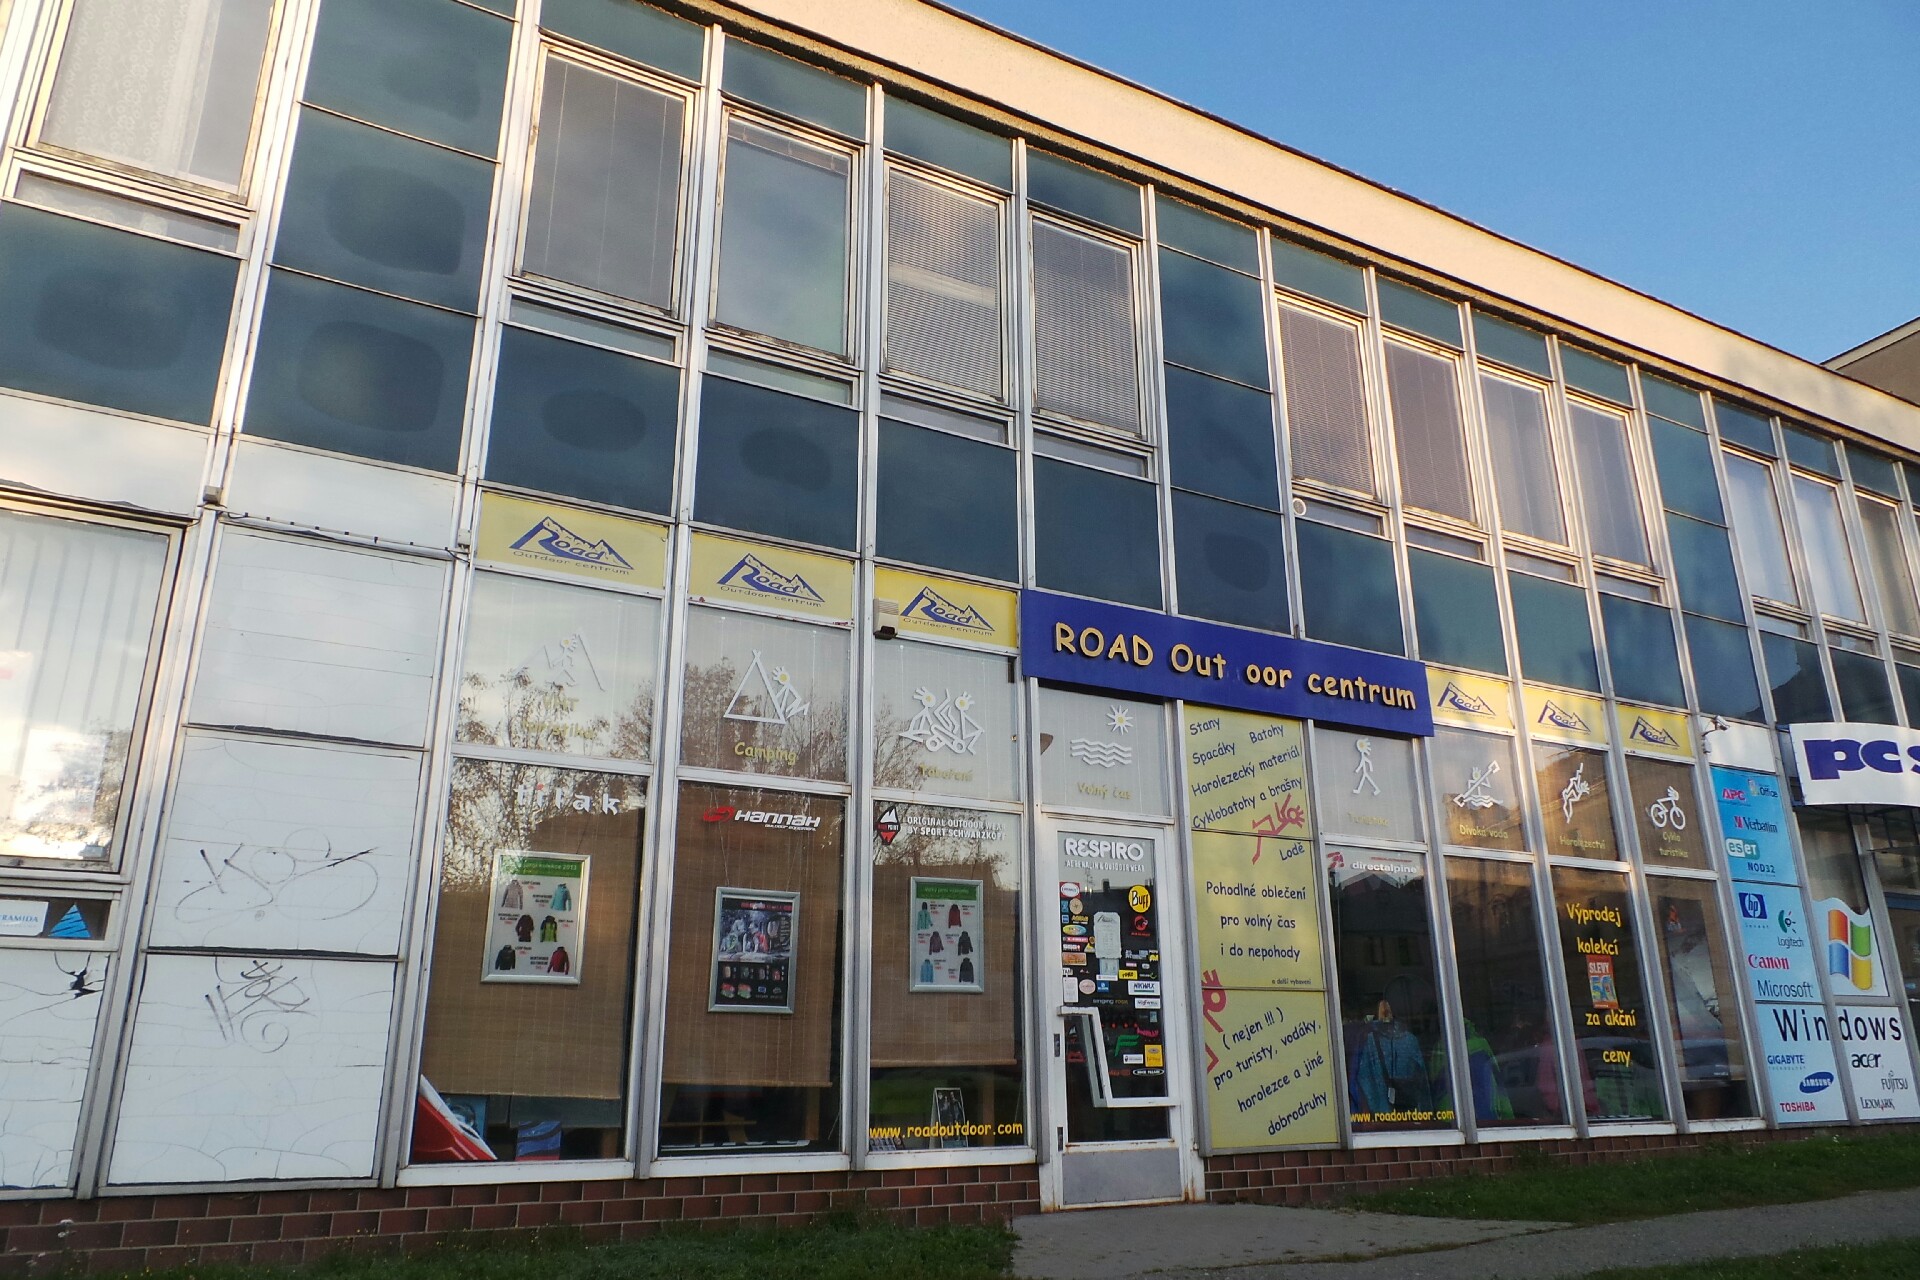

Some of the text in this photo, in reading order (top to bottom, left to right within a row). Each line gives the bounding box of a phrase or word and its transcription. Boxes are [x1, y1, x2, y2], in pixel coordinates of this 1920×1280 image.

[513, 550, 630, 575] Outdoor centrum
[720, 586, 821, 608] Outdoor centrum
[1054, 622, 1154, 667] ROAD
[1307, 671, 1417, 710] centrum
[1189, 718, 1220, 735] Stany
[1249, 725, 1284, 744] Batohy
[735, 741, 797, 766] Camping
[1192, 742, 1235, 765] Spacáky
[1191, 745, 1300, 796] Horolezecký materiál
[1192, 777, 1302, 829] Cyklobatohy a brašny
[1723, 788, 1746, 801] APC
[907, 816, 945, 828] ORIGINAL
[947, 819, 984, 830] OUTDOOR
[907, 826, 919, 835] BY
[920, 826, 947, 836] SPORT
[1743, 817, 1778, 833] Verbatim
[1065, 838, 1145, 861] RESPIRO
[1279, 842, 1305, 861] Lodě
[1352, 861, 1417, 874] directalpine
[1747, 862, 1776, 874] NOD32
[1131, 890, 1149, 909] Buff
[1206, 881, 1306, 900] Pohodlné oblečení
[0, 914, 38, 922] RAMIDA
[1220, 913, 1296, 931] pro volný čas
[1566, 902, 1621, 927] Výprodej
[1577, 936, 1618, 955] kolekcí
[1777, 936, 1805, 949] Logitech
[1229, 943, 1244, 957] do
[1248, 945, 1301, 962] nepohody
[1589, 962, 1610, 974] SLEVY
[1748, 954, 1790, 970] Canon
[1757, 980, 1813, 998] Microsoft
[1585, 1009, 1636, 1027] za akční
[1232, 1020, 1263, 1045] nejen
[1213, 1069, 1233, 1091] pro
[1235, 1042, 1278, 1074] turisty,
[1603, 1050, 1631, 1067] ceny
[1767, 1055, 1805, 1065] GIGABYTE
[1851, 1053, 1881, 1069] acer
[1237, 1051, 1324, 1113] horolezce a jiné
[1802, 1077, 1832, 1087] SAMSUNG
[1881, 1077, 1909, 1092] FUJITSU
[1779, 1102, 1816, 1112] TOSHIBA
[1859, 1096, 1895, 1111] LEXMARK
[1267, 1091, 1328, 1136] dobrodruhy
[1350, 1108, 1455, 1123] www.roadoutdoor.com
[869, 1119, 1023, 1138] www.roadoutdoor.com
